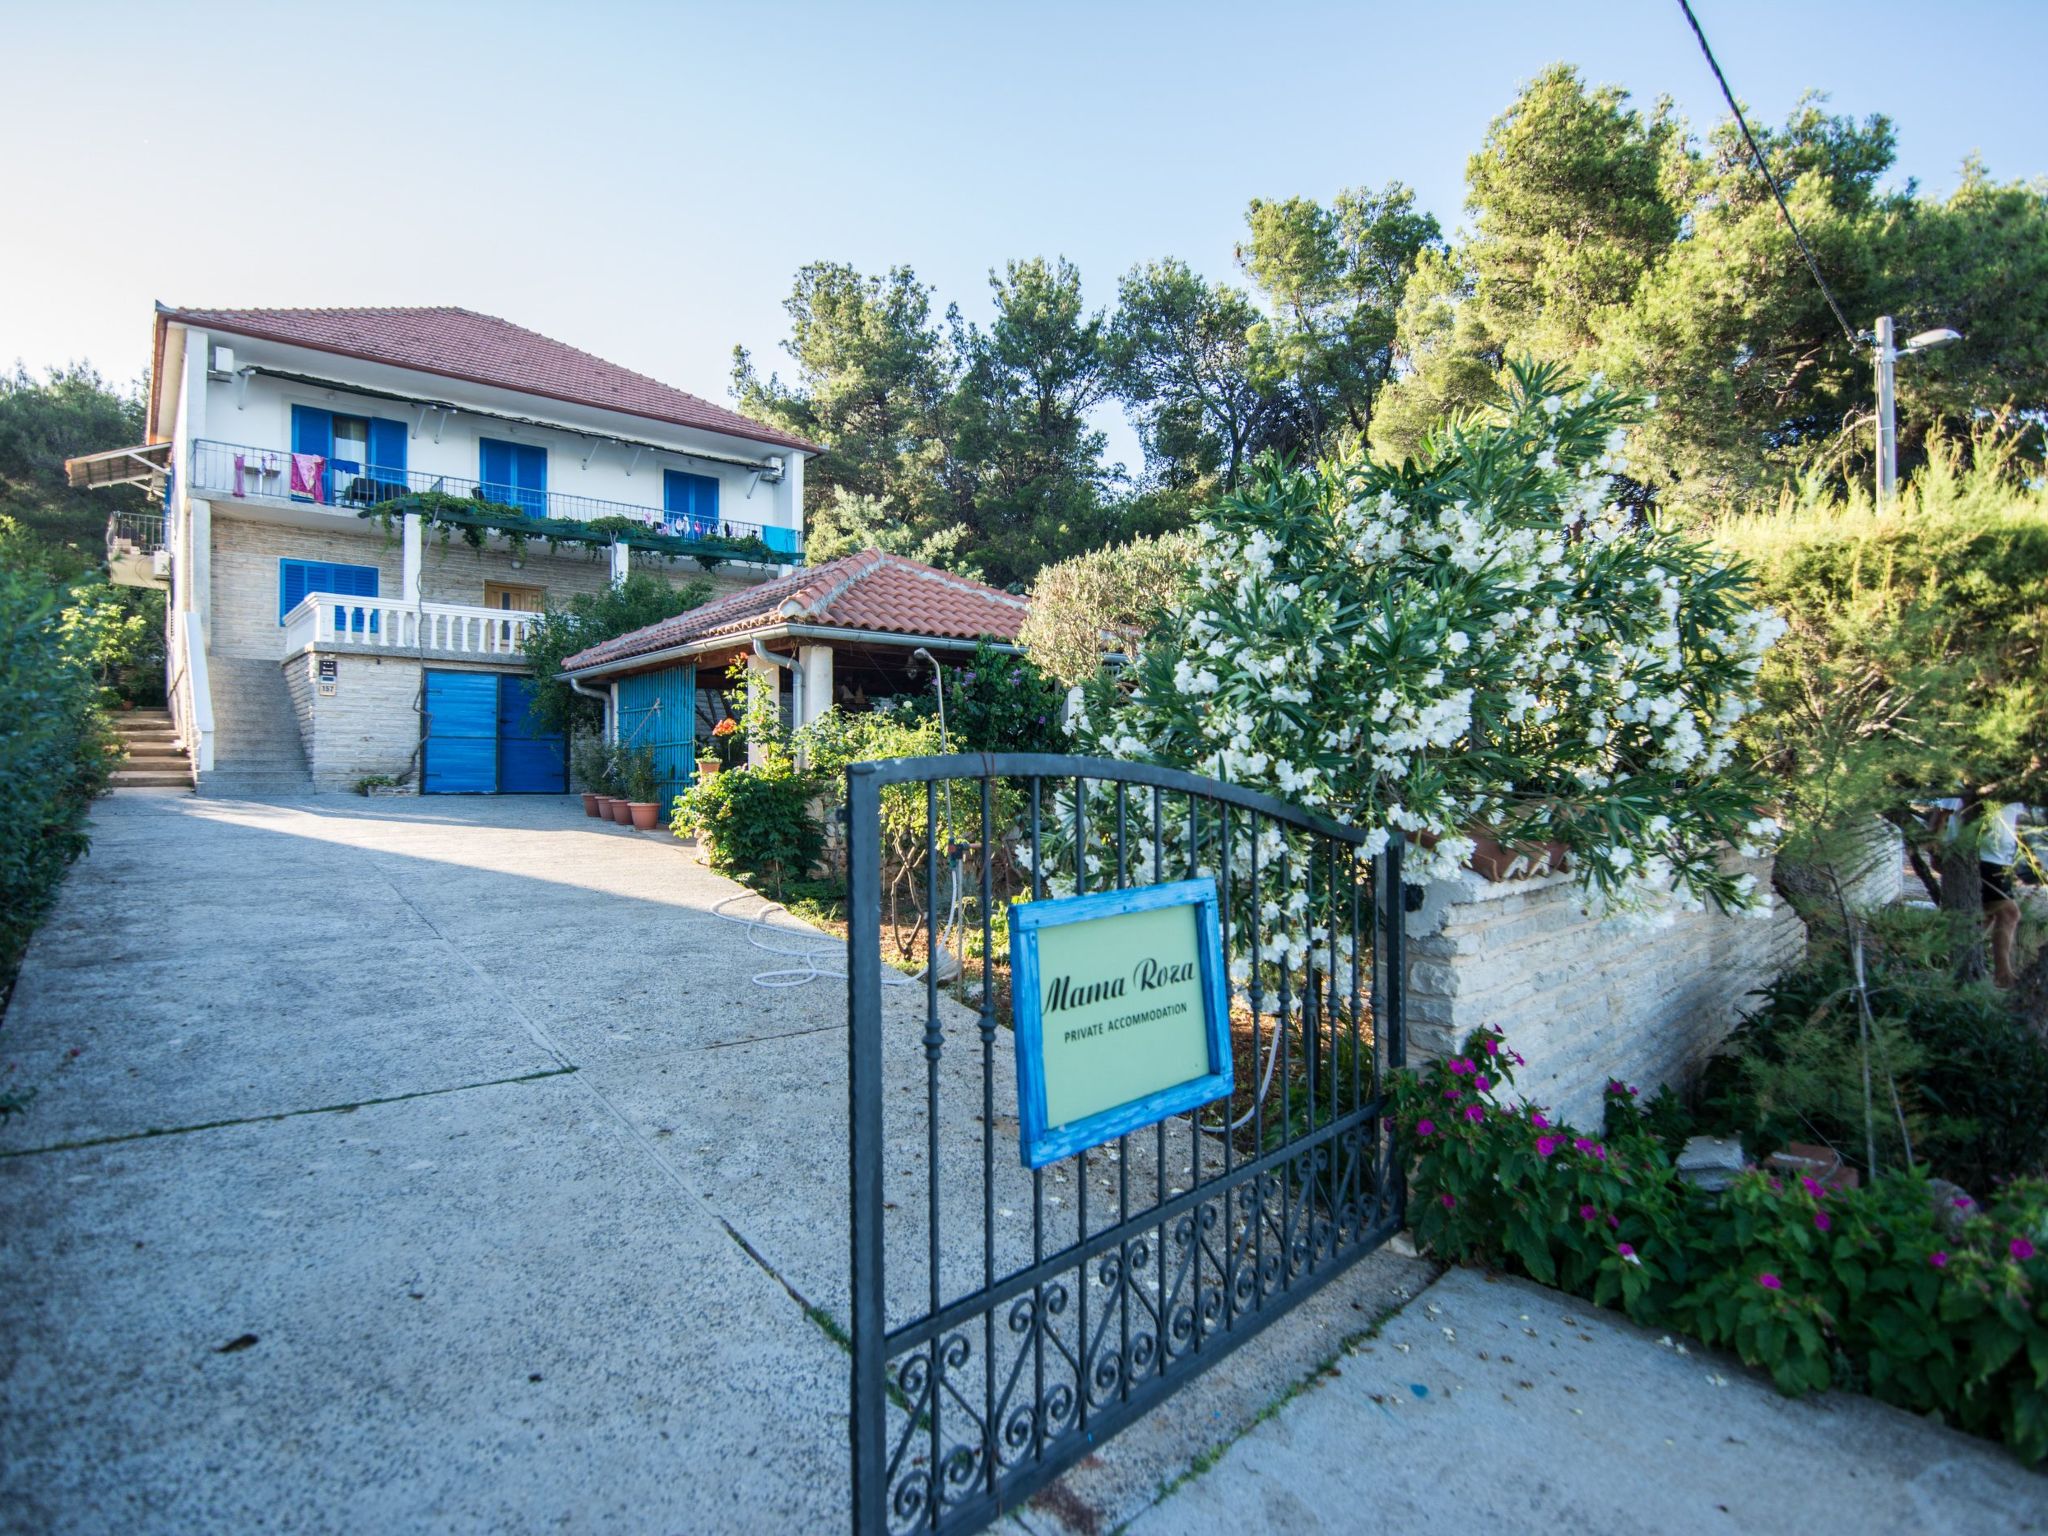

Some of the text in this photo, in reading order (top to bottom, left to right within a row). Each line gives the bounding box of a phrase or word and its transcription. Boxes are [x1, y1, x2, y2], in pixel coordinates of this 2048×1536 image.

[1041, 957, 1195, 1017] Mama Roza
[1064, 1002, 1187, 1043] PRIVATE ACCOMMODATION
